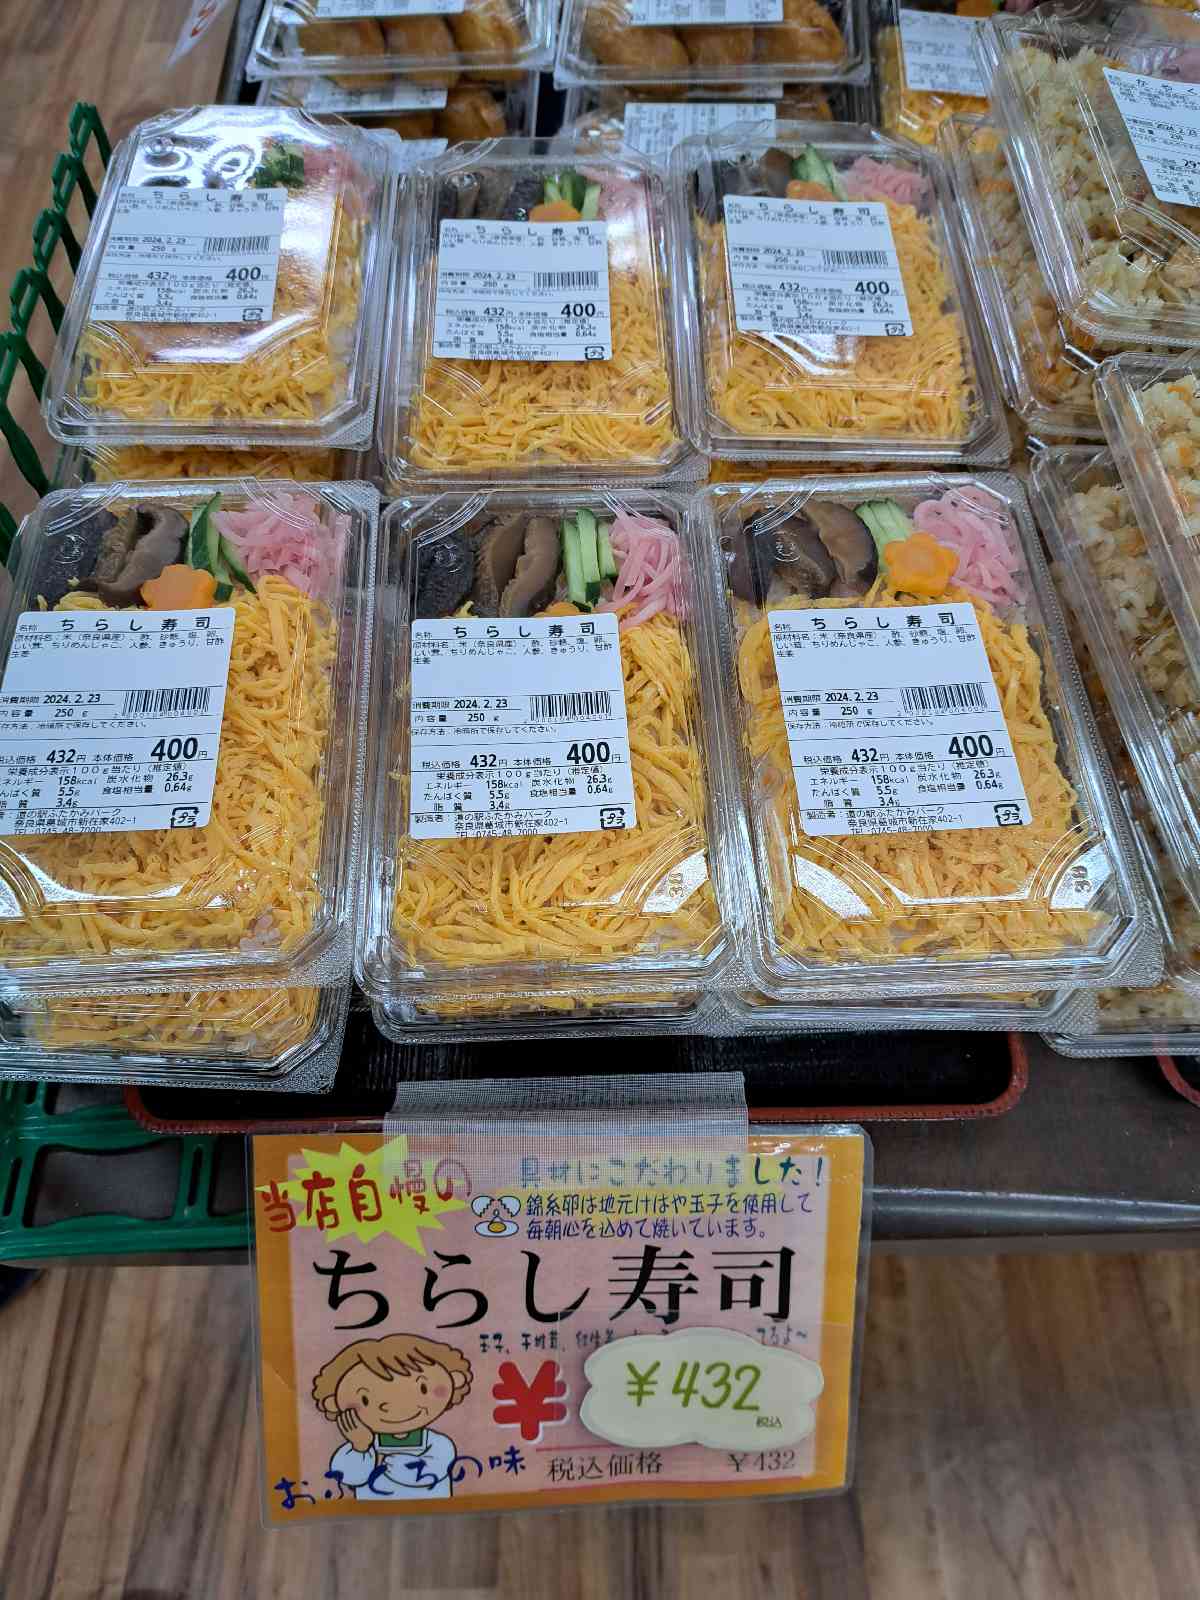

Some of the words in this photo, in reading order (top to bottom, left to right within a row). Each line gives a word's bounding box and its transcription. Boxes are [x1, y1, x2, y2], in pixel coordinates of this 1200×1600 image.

[61, 616, 212, 632] ちらし寿司
[811, 613, 956, 629] ちらし寿司
[453, 622, 595, 638] ちらし寿司
[54, 708, 74, 717] 250
[467, 713, 485, 722] 250
[841, 706, 859, 716] 250
[262, 1159, 472, 1232] 当店自慢の
[526, 1217, 768, 1240] 毎朝心を込めて焼いています。
[313, 1244, 796, 1329] ちらし寿司
[548, 1452, 663, 1482] 税込価格
